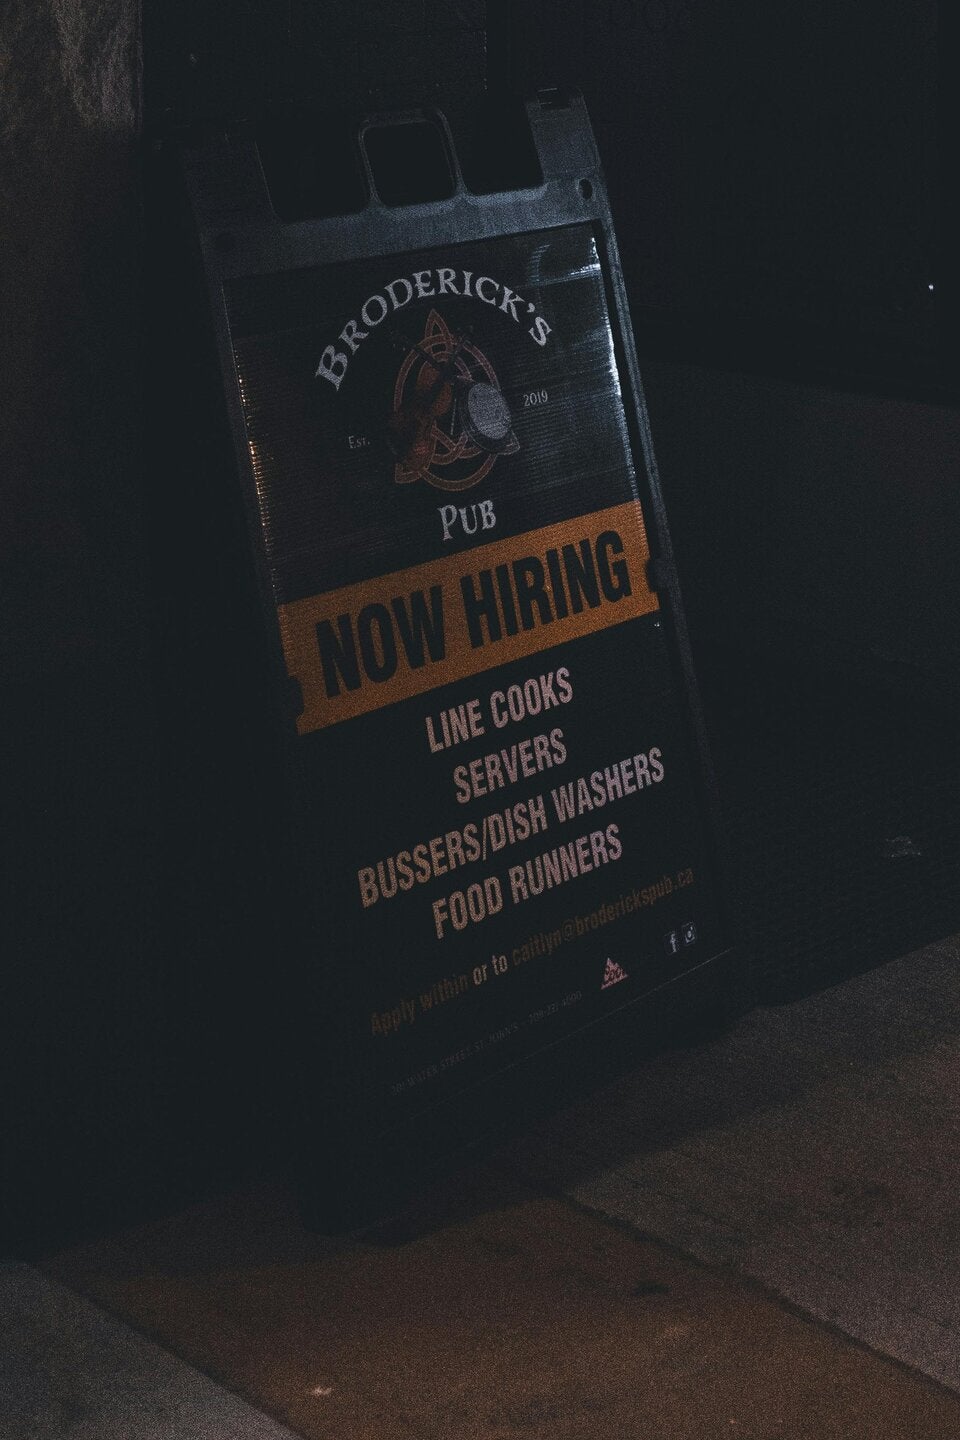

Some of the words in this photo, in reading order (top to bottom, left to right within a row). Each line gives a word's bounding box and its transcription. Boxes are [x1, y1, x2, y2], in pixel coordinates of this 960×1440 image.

[315, 267, 553, 391] BRODERICK'S
[523, 389, 549, 407] 2019
[315, 585, 447, 699] NOW
[461, 530, 633, 650] HIRING
[425, 698, 485, 754] LINE
[490, 666, 575, 729] COOKS
[453, 726, 568, 805] SERVERS
[357, 795, 548, 909] BUSSERS/DISH
[551, 747, 665, 823] WASHERS
[431, 877, 503, 940] FOOD
[508, 823, 624, 904] RUNNERS
[371, 999, 415, 1036] Apply
[420, 973, 469, 1011] within
[472, 963, 488, 986] or
[491, 954, 509, 976] to
[512, 867, 695, 966] caitlyn@broderickspub.ca
